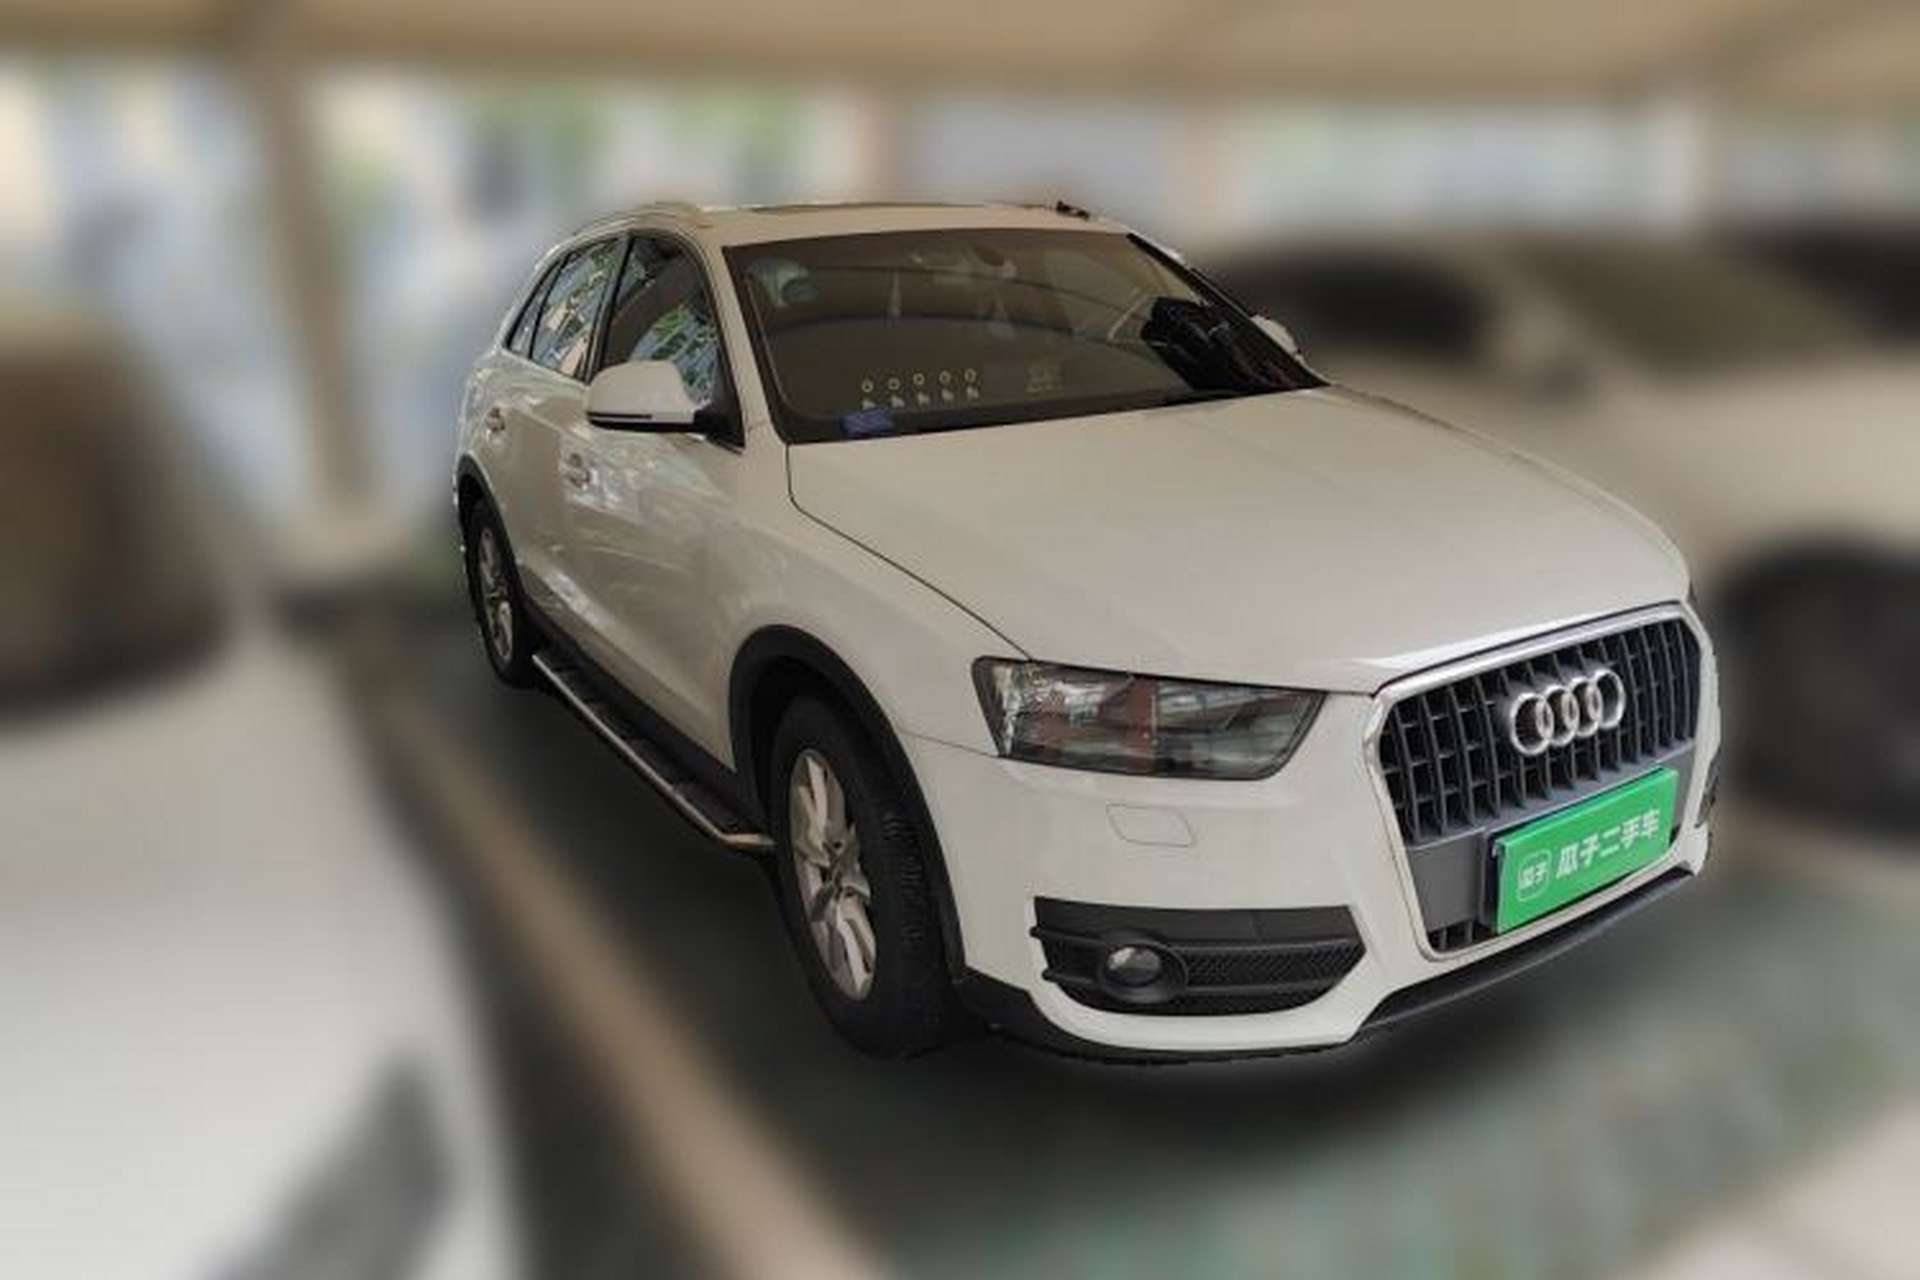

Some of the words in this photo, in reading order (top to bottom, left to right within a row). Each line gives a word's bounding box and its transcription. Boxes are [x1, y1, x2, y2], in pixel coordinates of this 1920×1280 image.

[1556, 808, 1660, 879] 瓜子二手车
